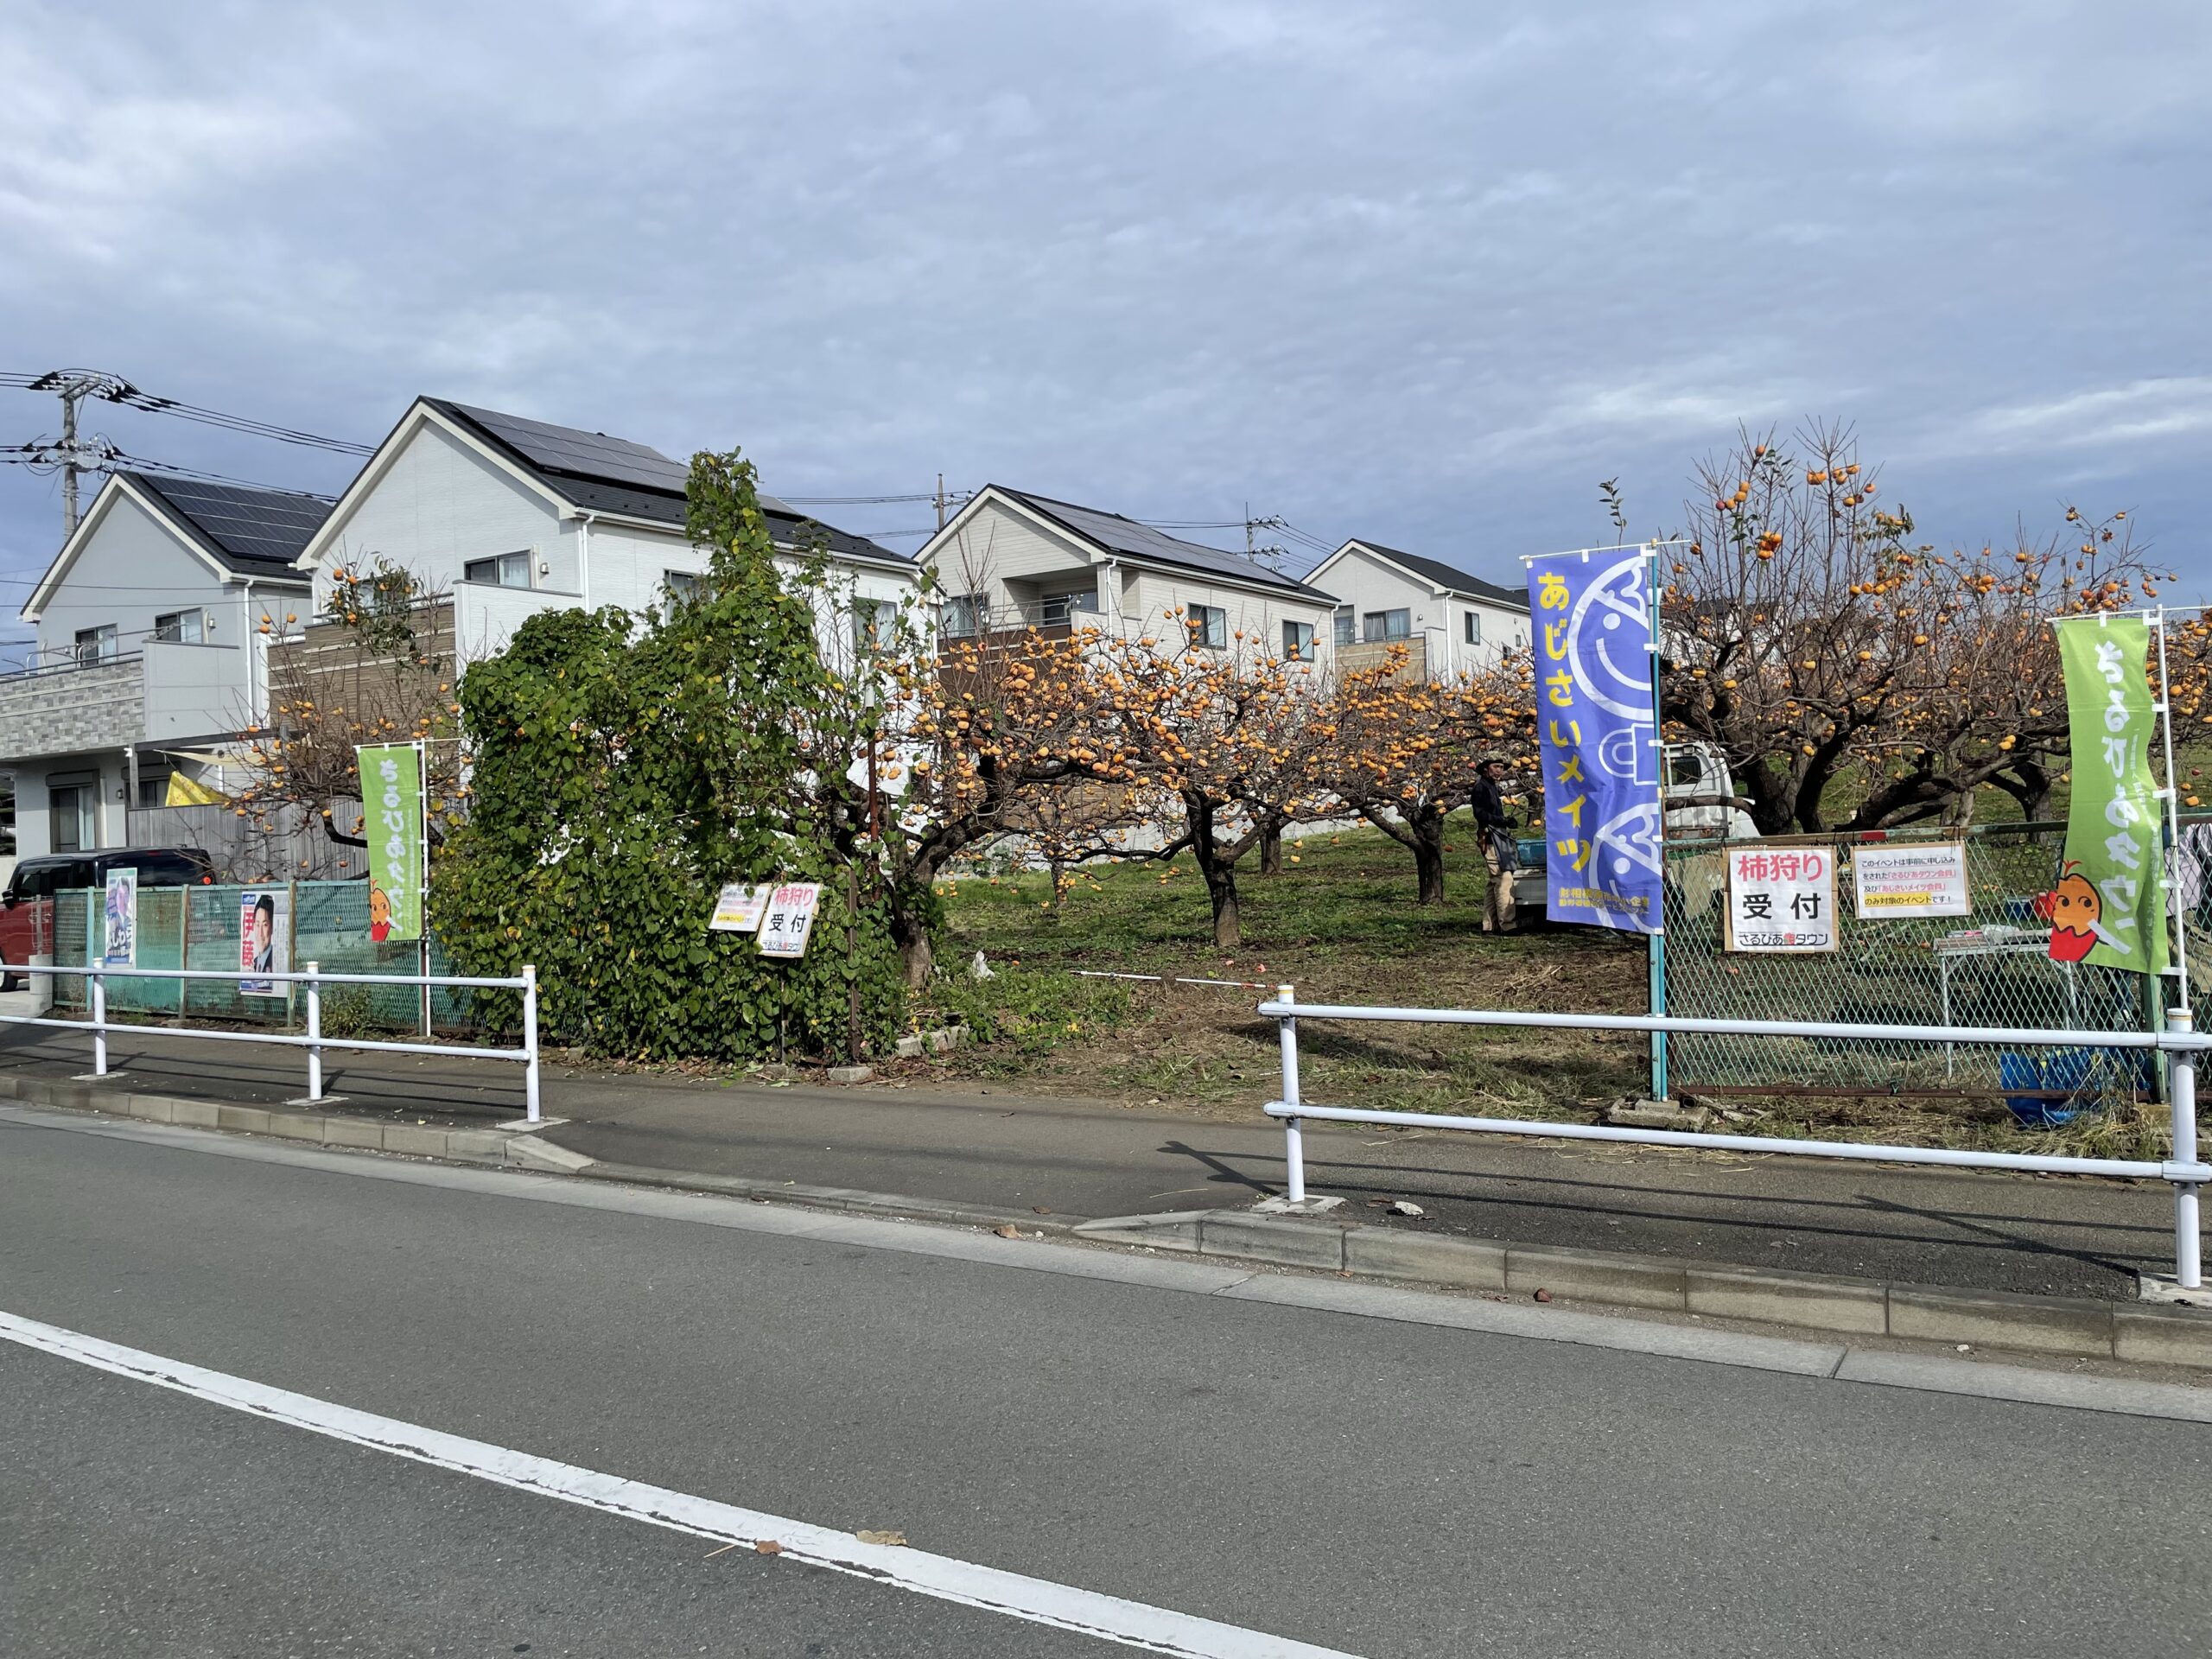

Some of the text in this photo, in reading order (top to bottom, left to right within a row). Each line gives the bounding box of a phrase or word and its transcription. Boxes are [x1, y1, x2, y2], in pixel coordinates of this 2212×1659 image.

[1537, 571, 1592, 873] あじさいメイツ
[1738, 853, 1823, 883] 柿狩り
[774, 887, 814, 907] 柿狩り
[1742, 893, 1821, 920] 受付
[768, 913, 807, 933] 受付
[242, 912, 256, 966] 伊藤
[1738, 932, 1828, 947] さるびあタウン
